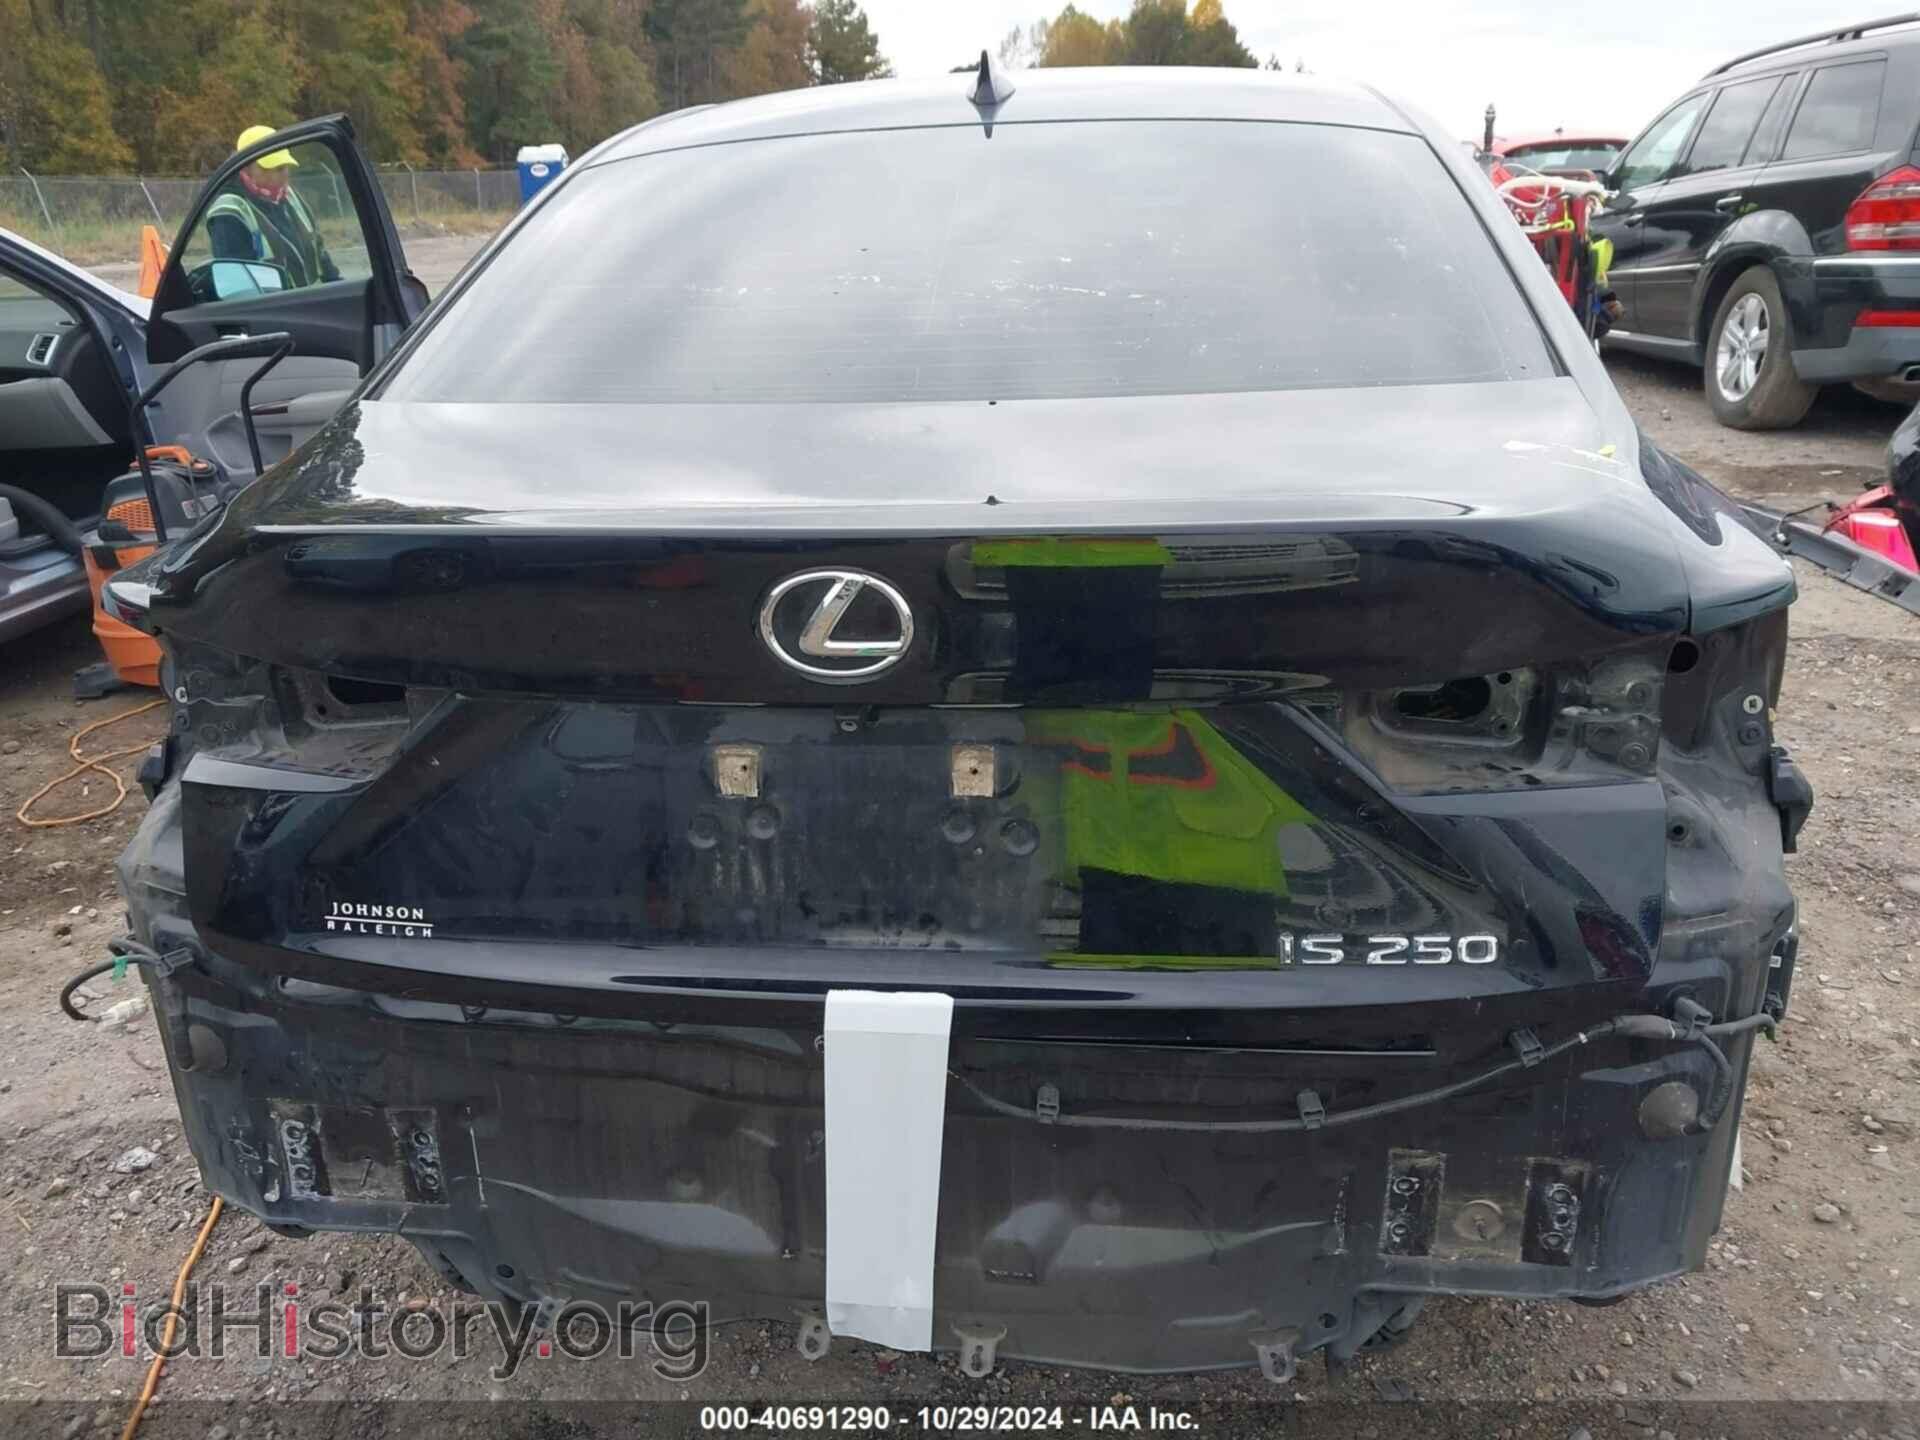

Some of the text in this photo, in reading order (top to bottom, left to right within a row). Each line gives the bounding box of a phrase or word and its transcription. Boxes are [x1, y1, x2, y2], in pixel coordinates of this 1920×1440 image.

[332, 902, 424, 920] JOHNSON
[326, 920, 432, 937] RALEIGH
[1279, 932, 1499, 965] IS 250
